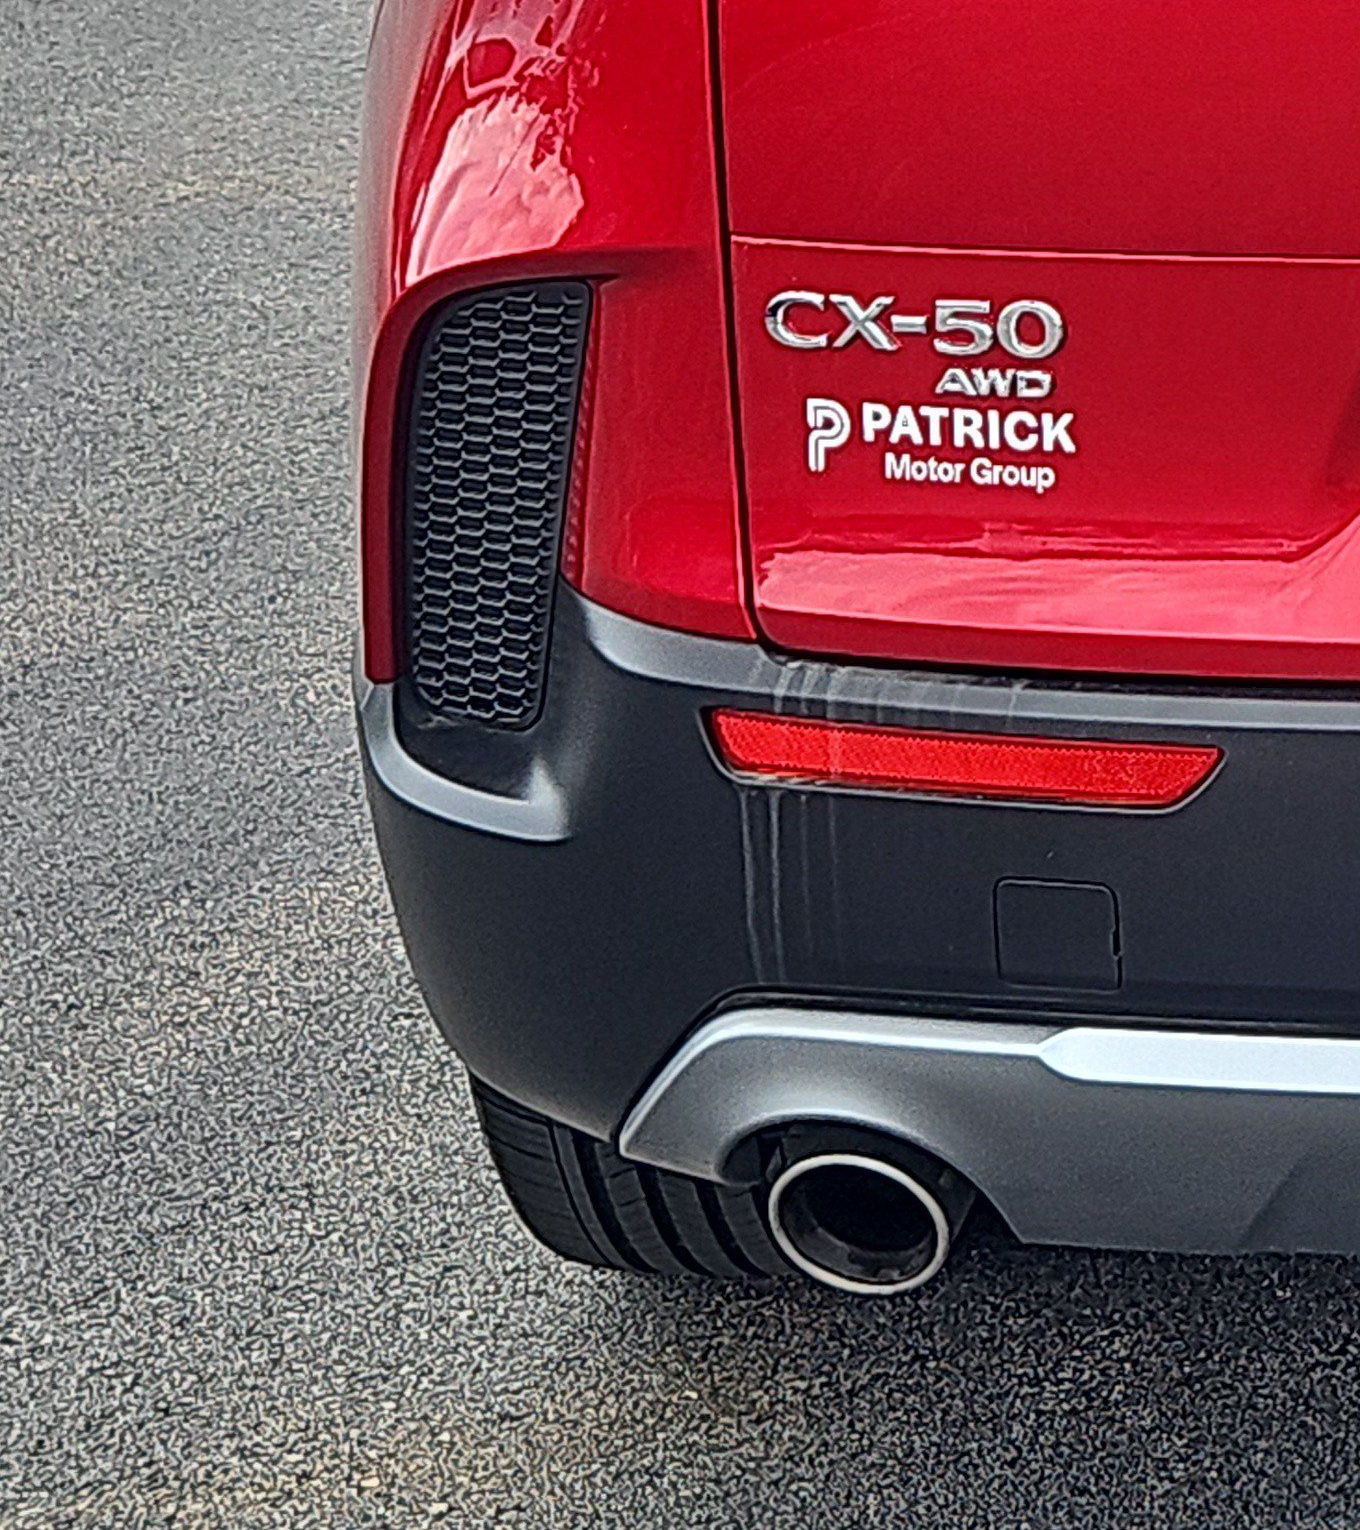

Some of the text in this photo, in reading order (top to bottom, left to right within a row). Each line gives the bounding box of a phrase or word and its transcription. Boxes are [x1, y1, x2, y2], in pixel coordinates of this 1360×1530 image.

[764, 290, 1065, 359] CX-50
[934, 368, 1054, 398] AWD
[861, 402, 1077, 454] PATRICK
[884, 451, 1056, 494] Motor Group
